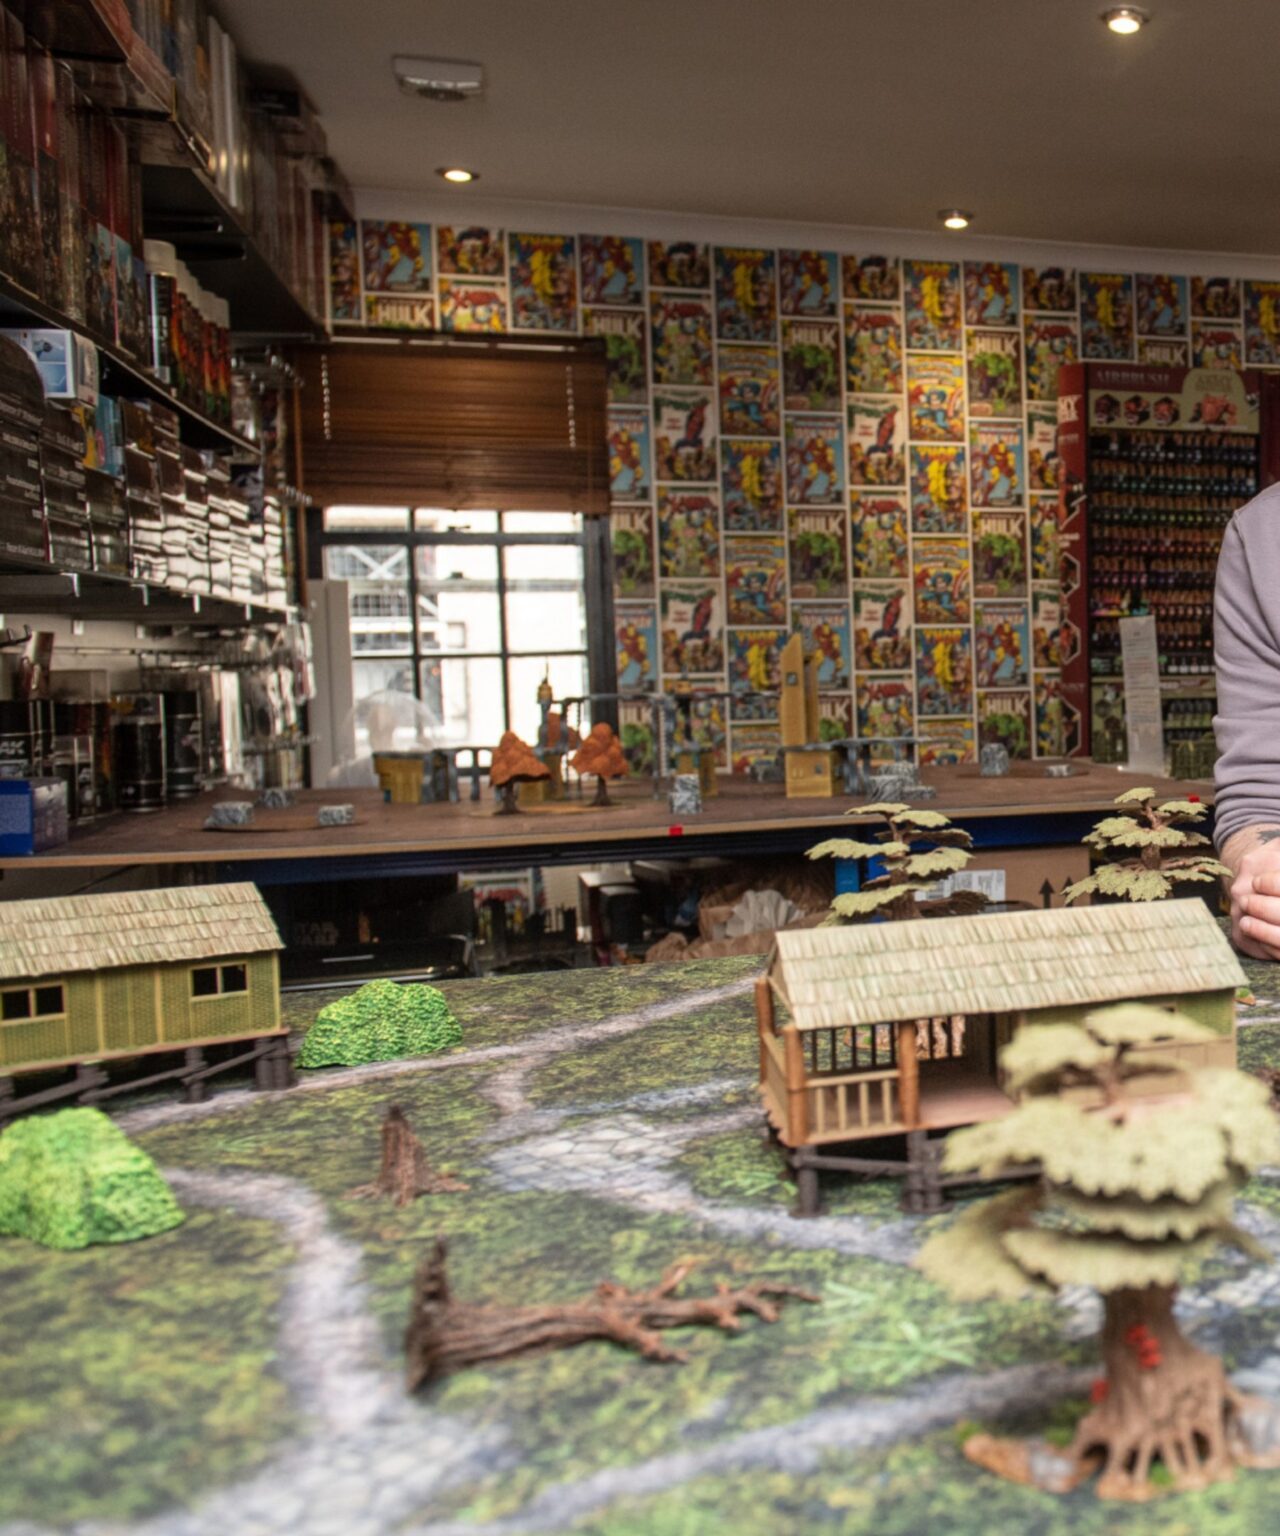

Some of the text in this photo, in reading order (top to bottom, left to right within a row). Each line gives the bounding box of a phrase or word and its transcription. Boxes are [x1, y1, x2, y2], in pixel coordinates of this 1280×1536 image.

[377, 300, 432, 327] HULK
[975, 334, 1018, 358] HULK
[1095, 369, 1170, 387] AIRBRUSH
[981, 516, 1024, 538] HULK
[986, 698, 1029, 718] HULK
